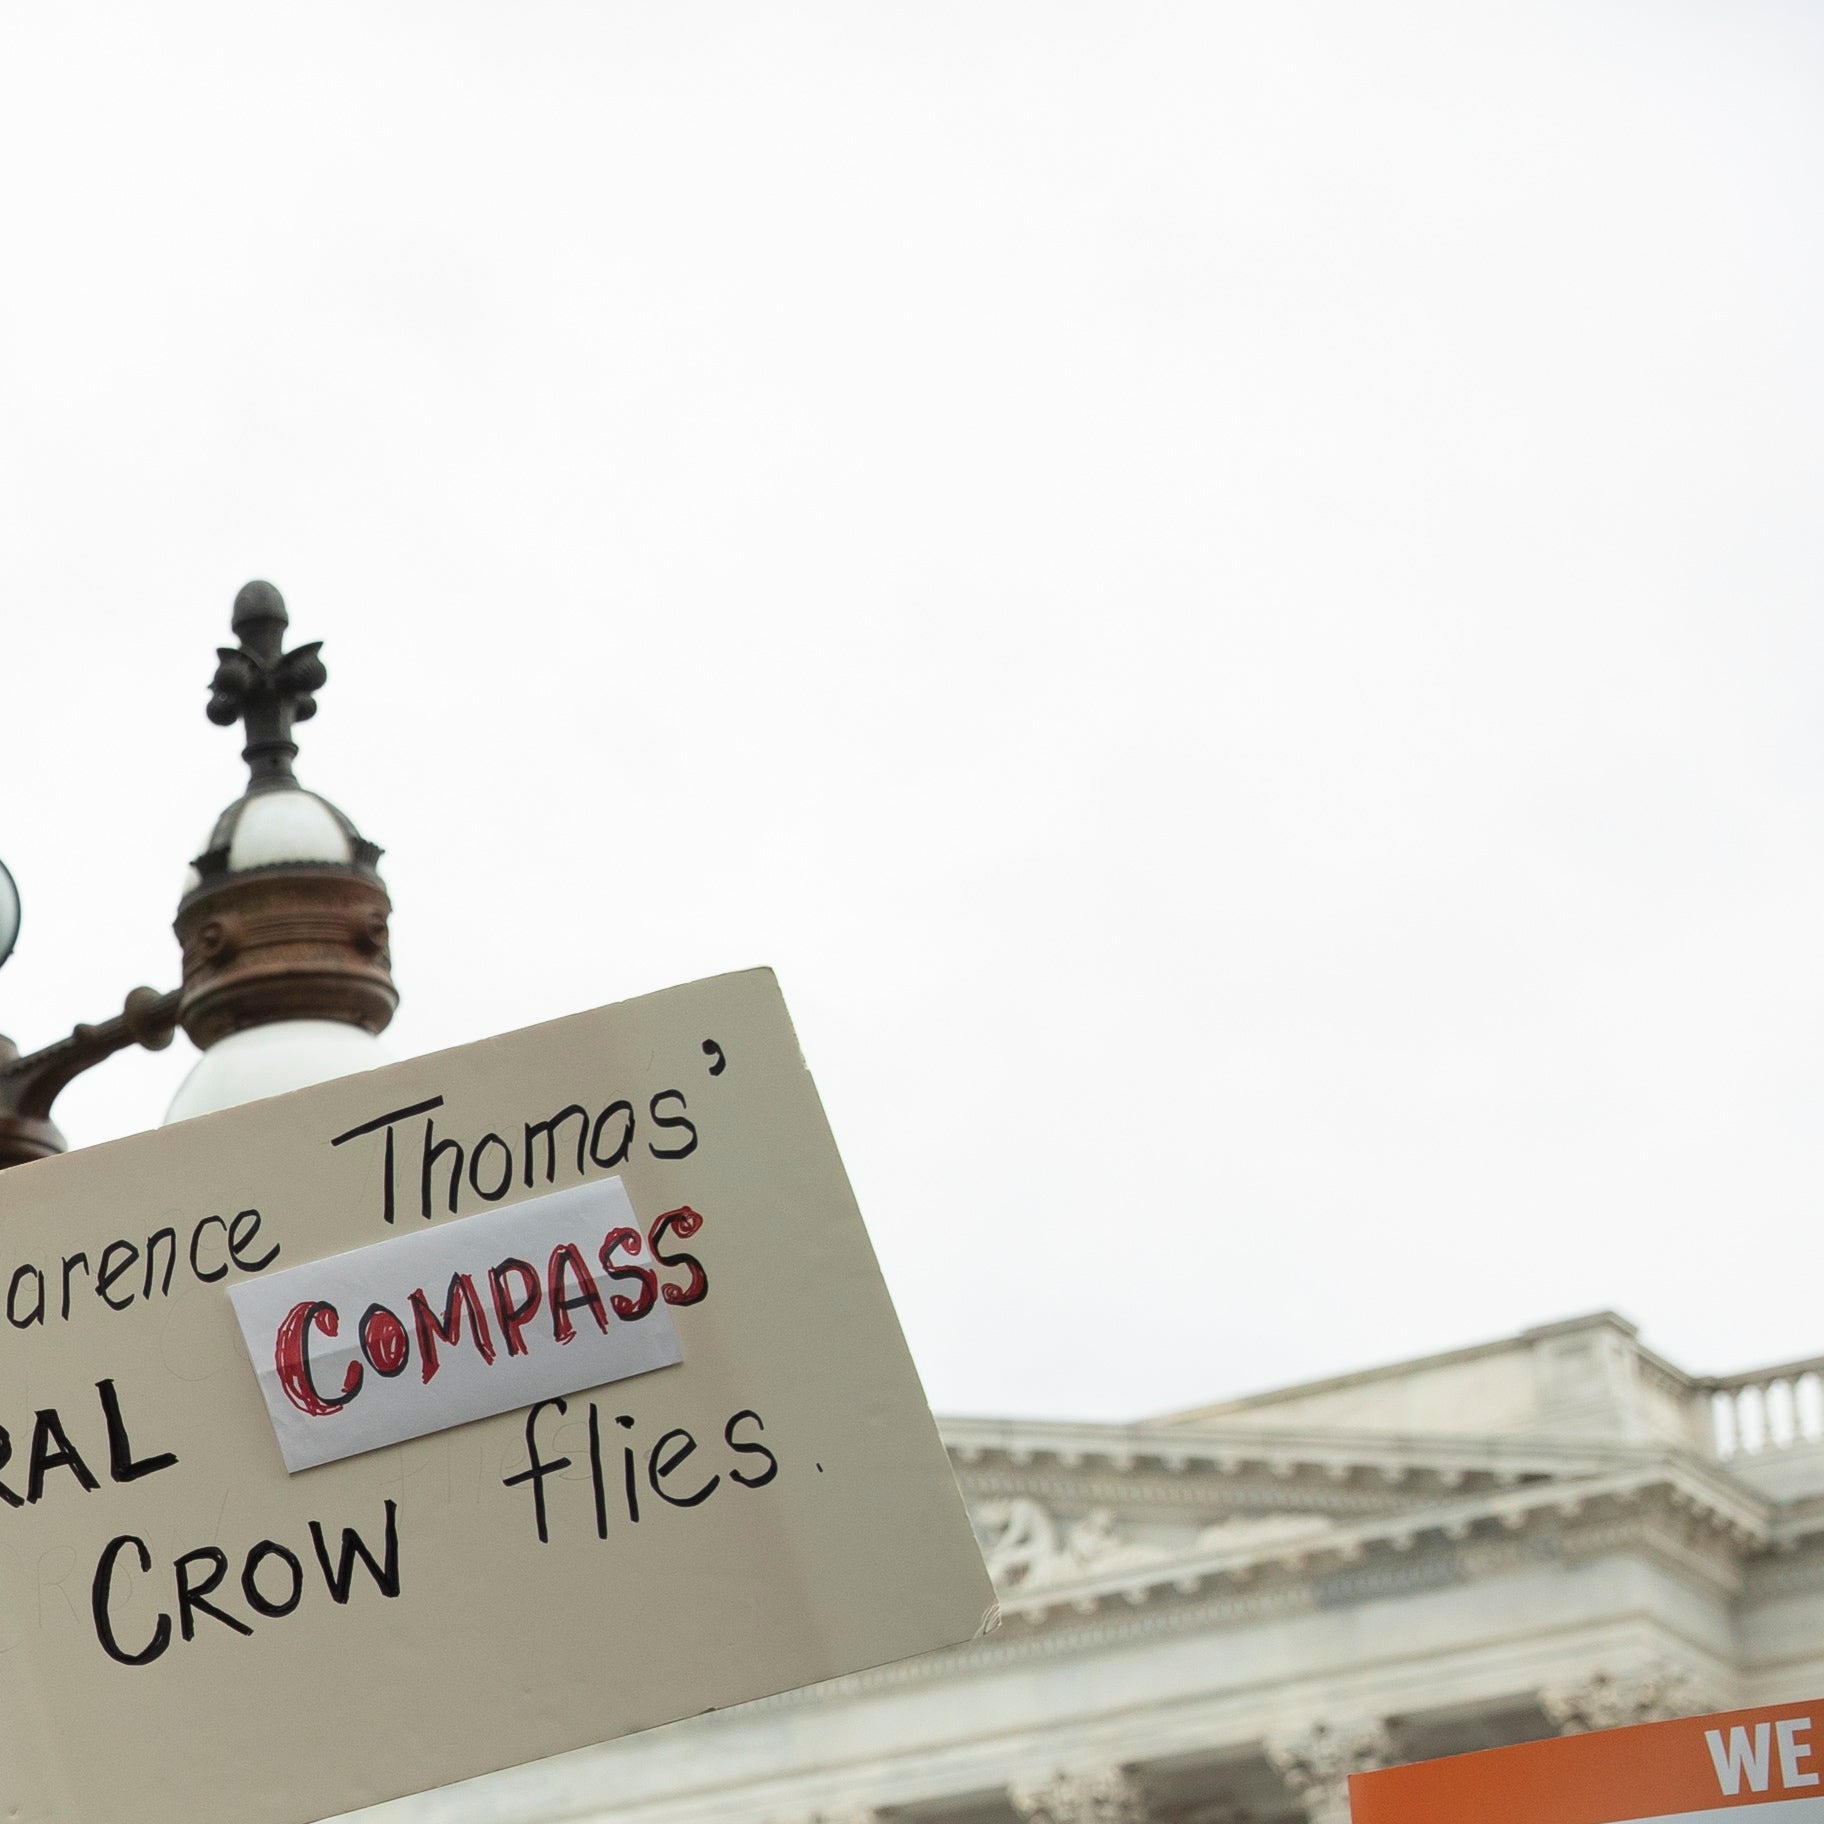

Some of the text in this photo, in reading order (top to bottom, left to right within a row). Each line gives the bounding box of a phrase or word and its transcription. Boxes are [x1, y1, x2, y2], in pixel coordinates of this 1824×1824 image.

[333, 1038, 727, 1226] Thomas'
[276, 1203, 710, 1420] COMPASS
[92, 1502, 402, 1667] CROW
[1705, 1716, 1819, 1797] WE
